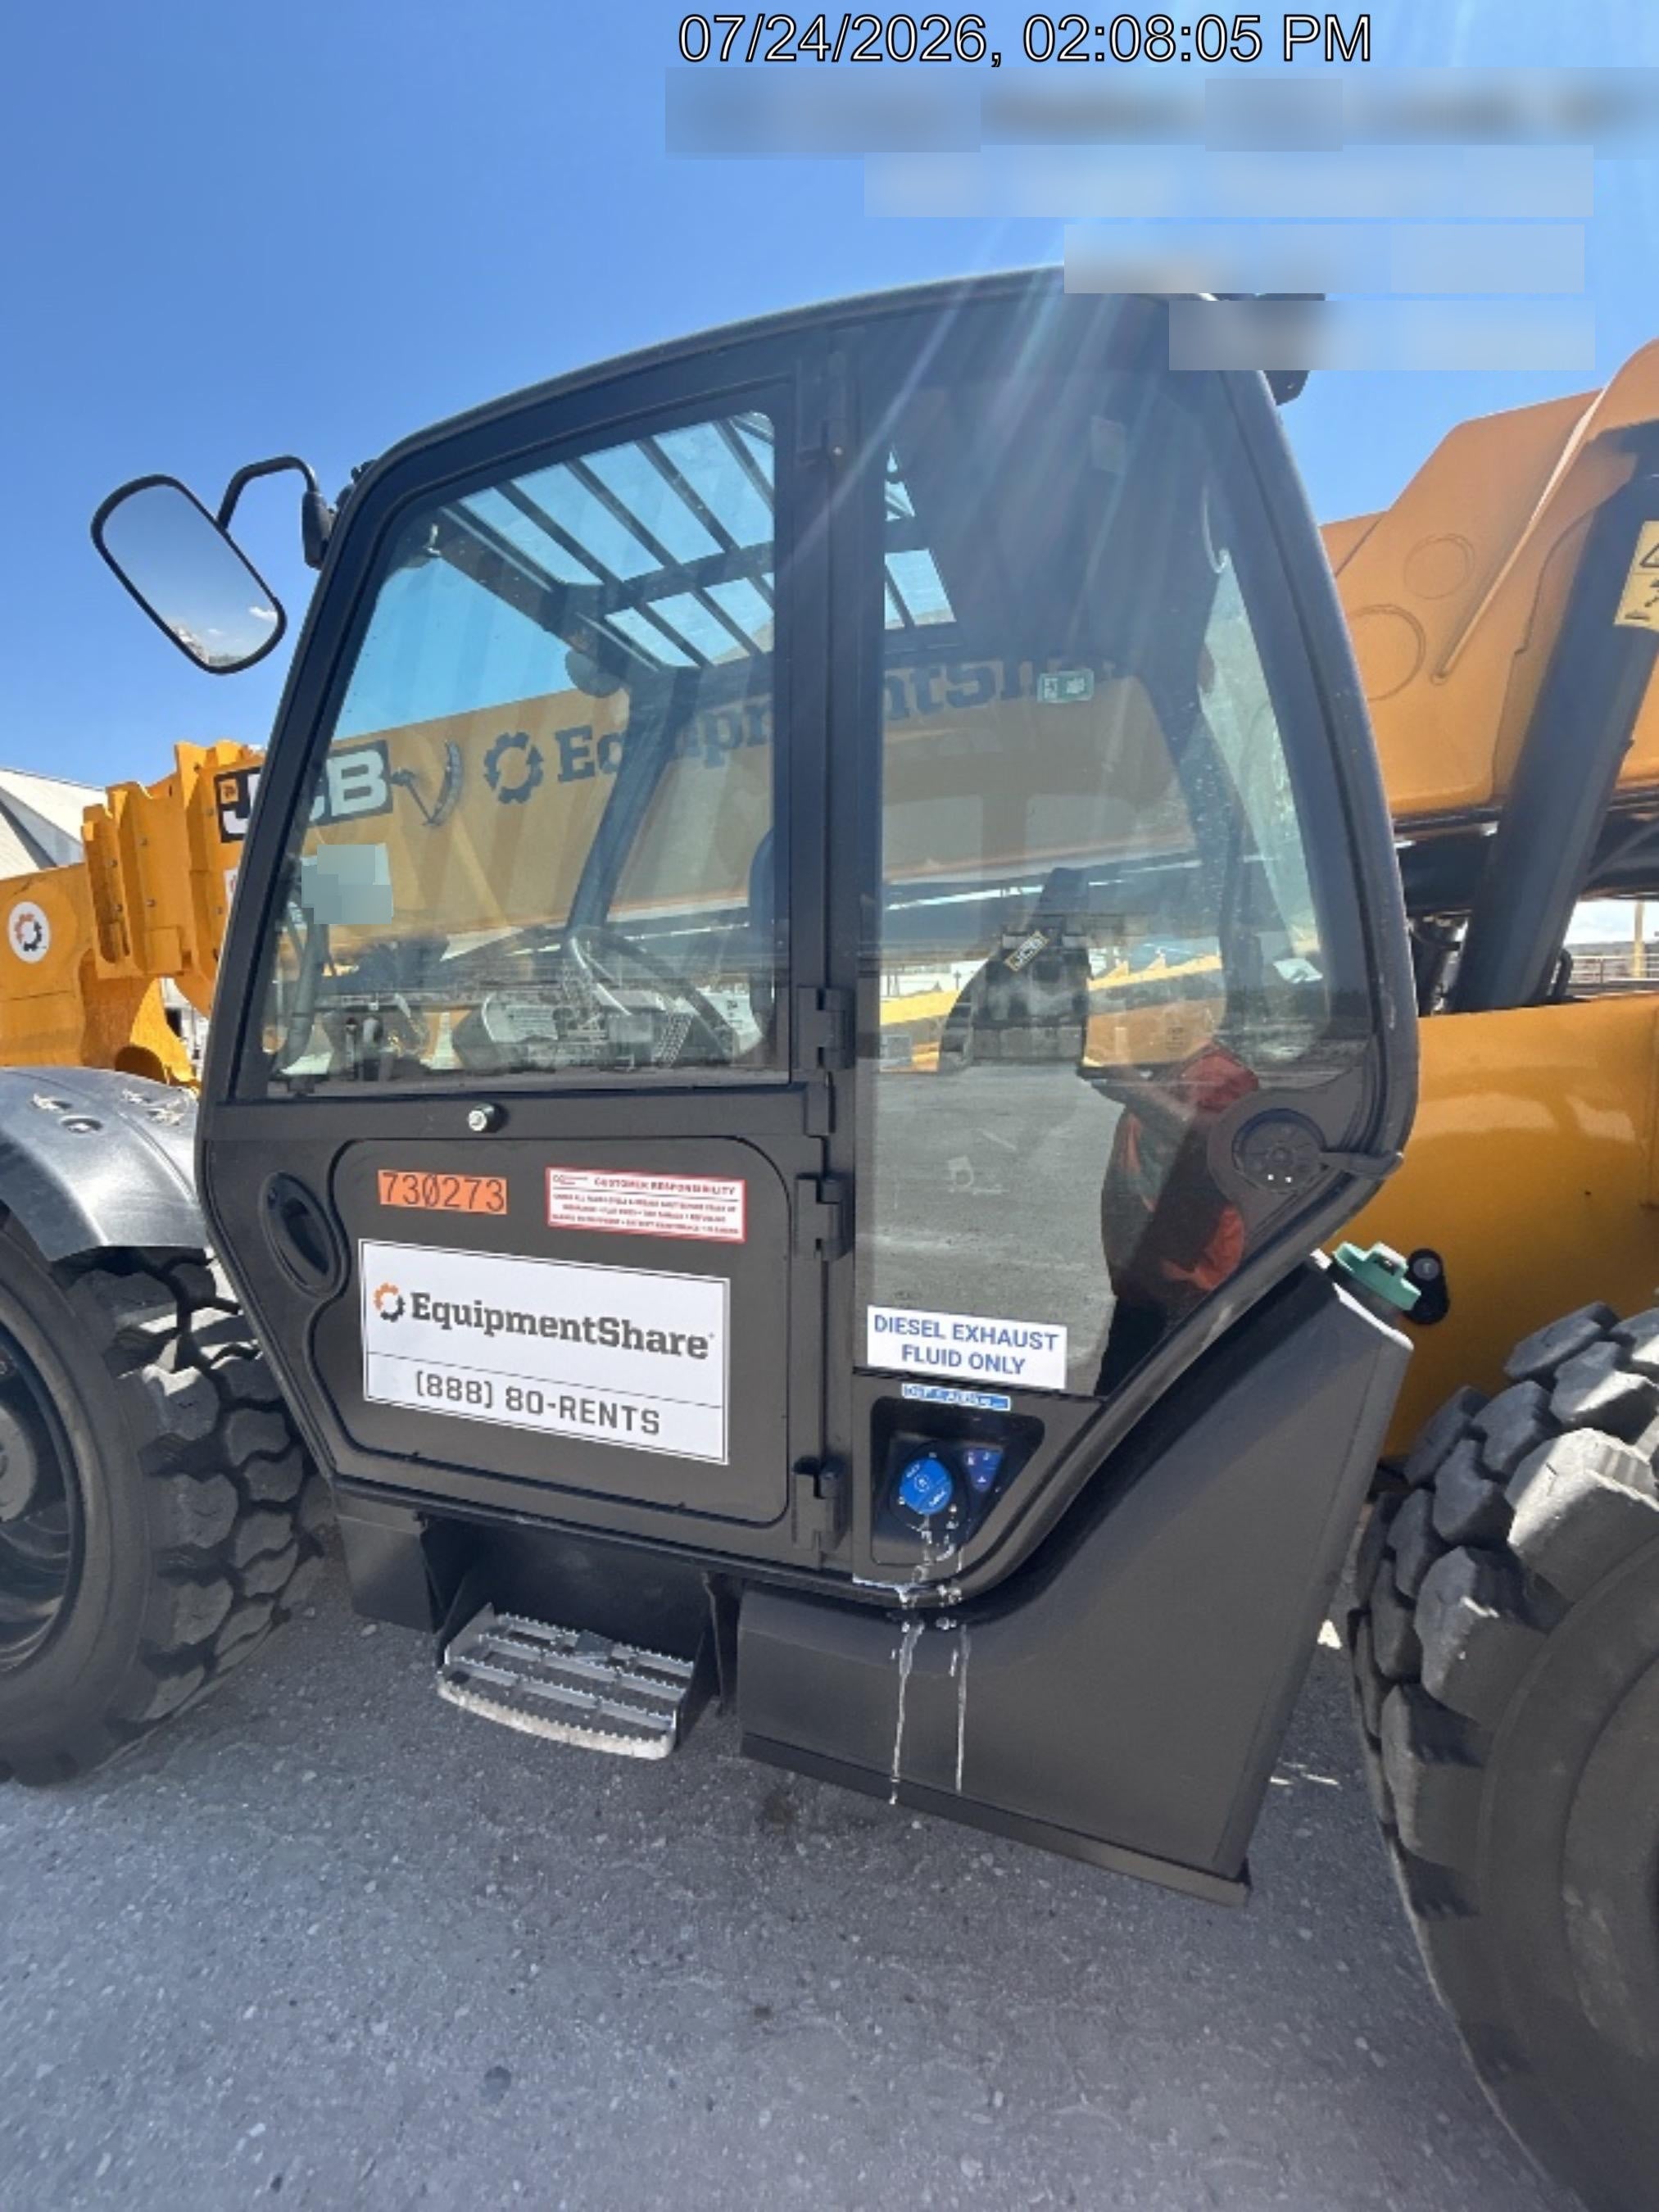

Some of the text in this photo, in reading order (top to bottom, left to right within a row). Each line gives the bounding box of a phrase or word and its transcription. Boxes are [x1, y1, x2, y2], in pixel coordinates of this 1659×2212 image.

[221, 747, 388, 836] JB
[383, 1172, 505, 1212] 730273
[593, 1176, 648, 1190] CUSTOMER
[411, 1292, 709, 1360] EquipmentShare
[874, 1315, 1058, 1351] DIESEL EXHAUST
[902, 1344, 1026, 1375] FLUID ONLY
[415, 1370, 660, 1435] (888) 80-RENTS
